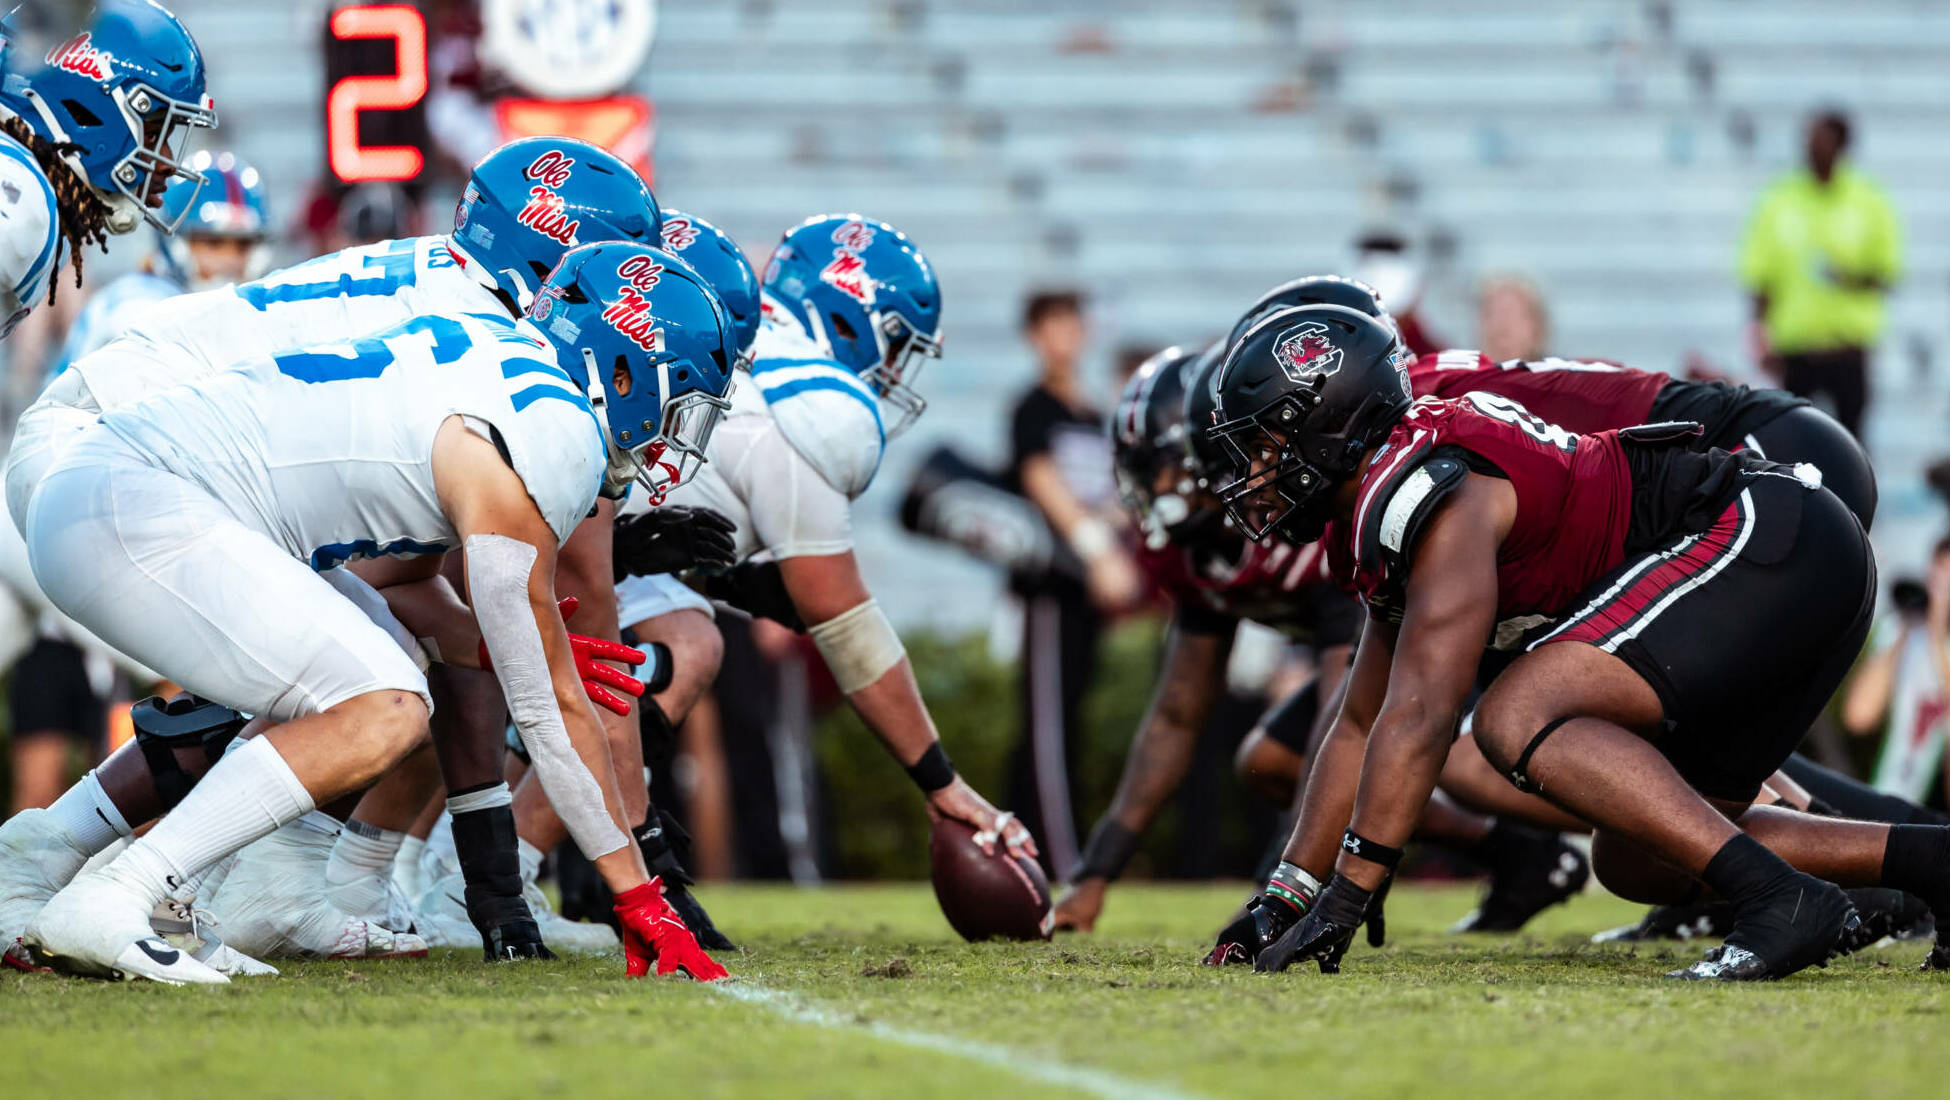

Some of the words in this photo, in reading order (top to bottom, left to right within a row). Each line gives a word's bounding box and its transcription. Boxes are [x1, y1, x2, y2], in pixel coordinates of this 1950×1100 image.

[327, 4, 428, 182] 2
[529, 150, 575, 188] Ole
[517, 186, 580, 248] Miss
[662, 218, 701, 250] Ole
[831, 220, 877, 252] Ole
[617, 254, 664, 292] Ole
[601, 286, 657, 351] Miss
